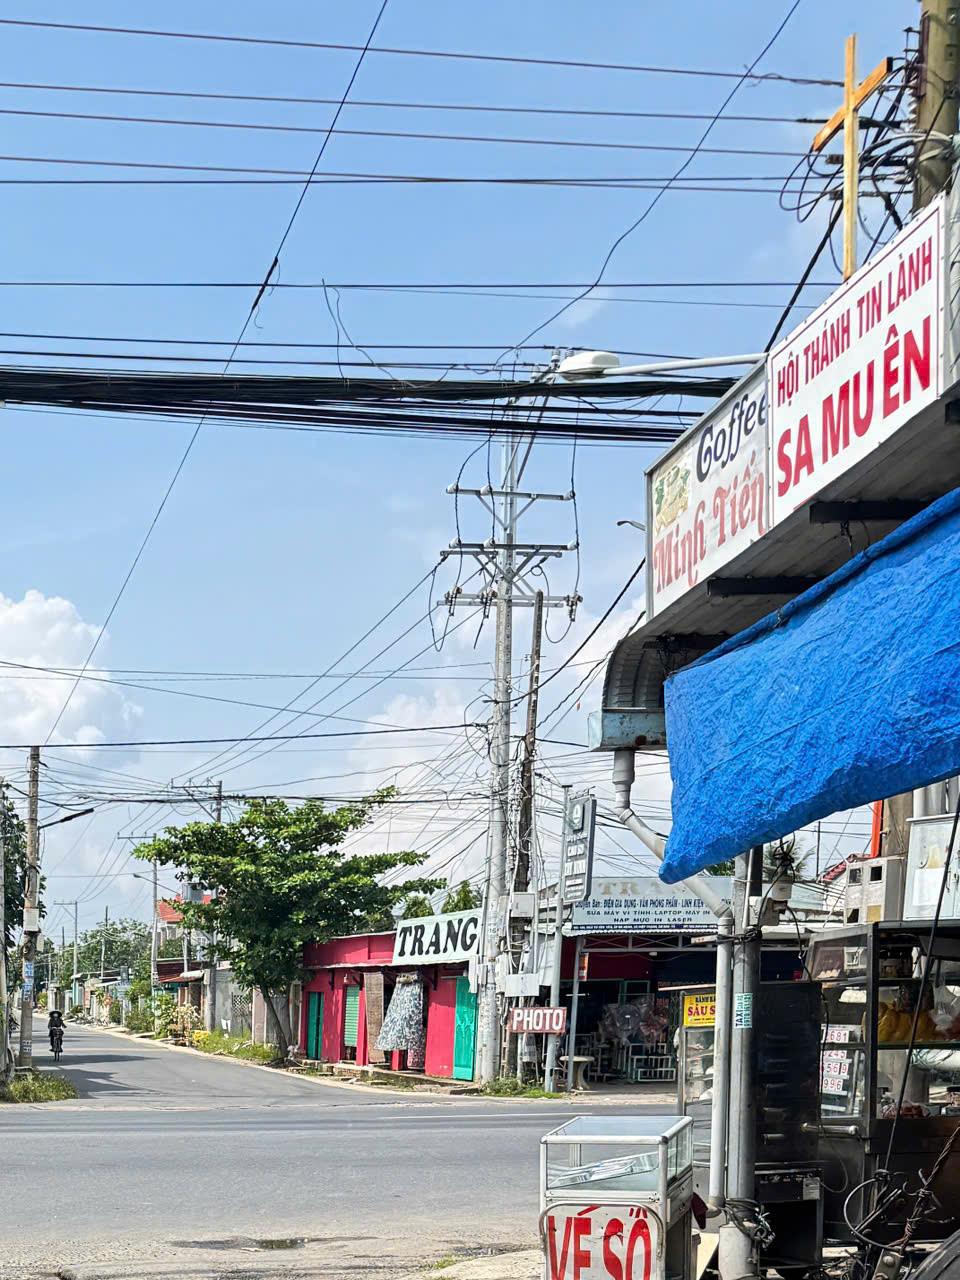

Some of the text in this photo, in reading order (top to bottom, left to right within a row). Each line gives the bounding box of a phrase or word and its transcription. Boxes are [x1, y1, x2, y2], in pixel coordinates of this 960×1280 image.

[777, 236, 933, 408] HỘI THÁNH TIN LÀNH
[777, 414, 815, 498] SA
[653, 500, 706, 594] Minh
[398, 917, 479, 957] TRANG
[512, 1009, 563, 1031] PHOTO
[735, 1009, 743, 1027] TAXI
